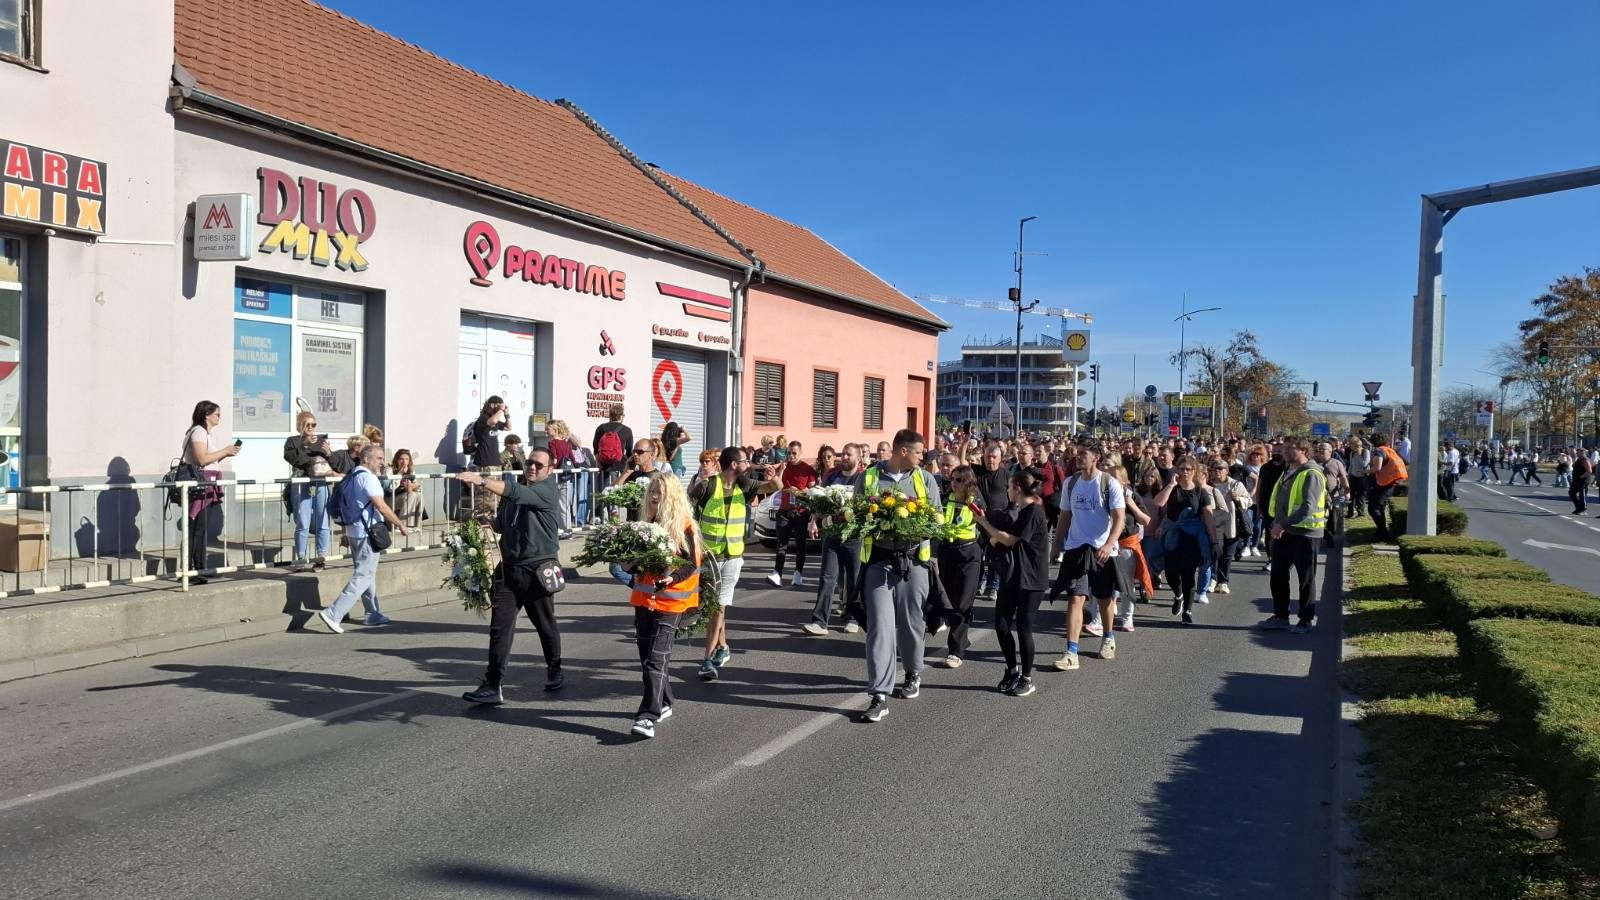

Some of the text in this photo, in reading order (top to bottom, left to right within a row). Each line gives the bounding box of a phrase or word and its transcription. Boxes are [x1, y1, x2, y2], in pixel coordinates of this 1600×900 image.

[4, 143, 103, 195] ARA
[4, 182, 103, 232] MIX
[257, 167, 377, 244] DUO
[222, 234, 236, 243] spa
[258, 220, 369, 272] MIX
[504, 245, 626, 300] PRATIME
[321, 300, 340, 318] HEL
[332, 341, 352, 350] SISTEM
[588, 365, 627, 391] GPS
